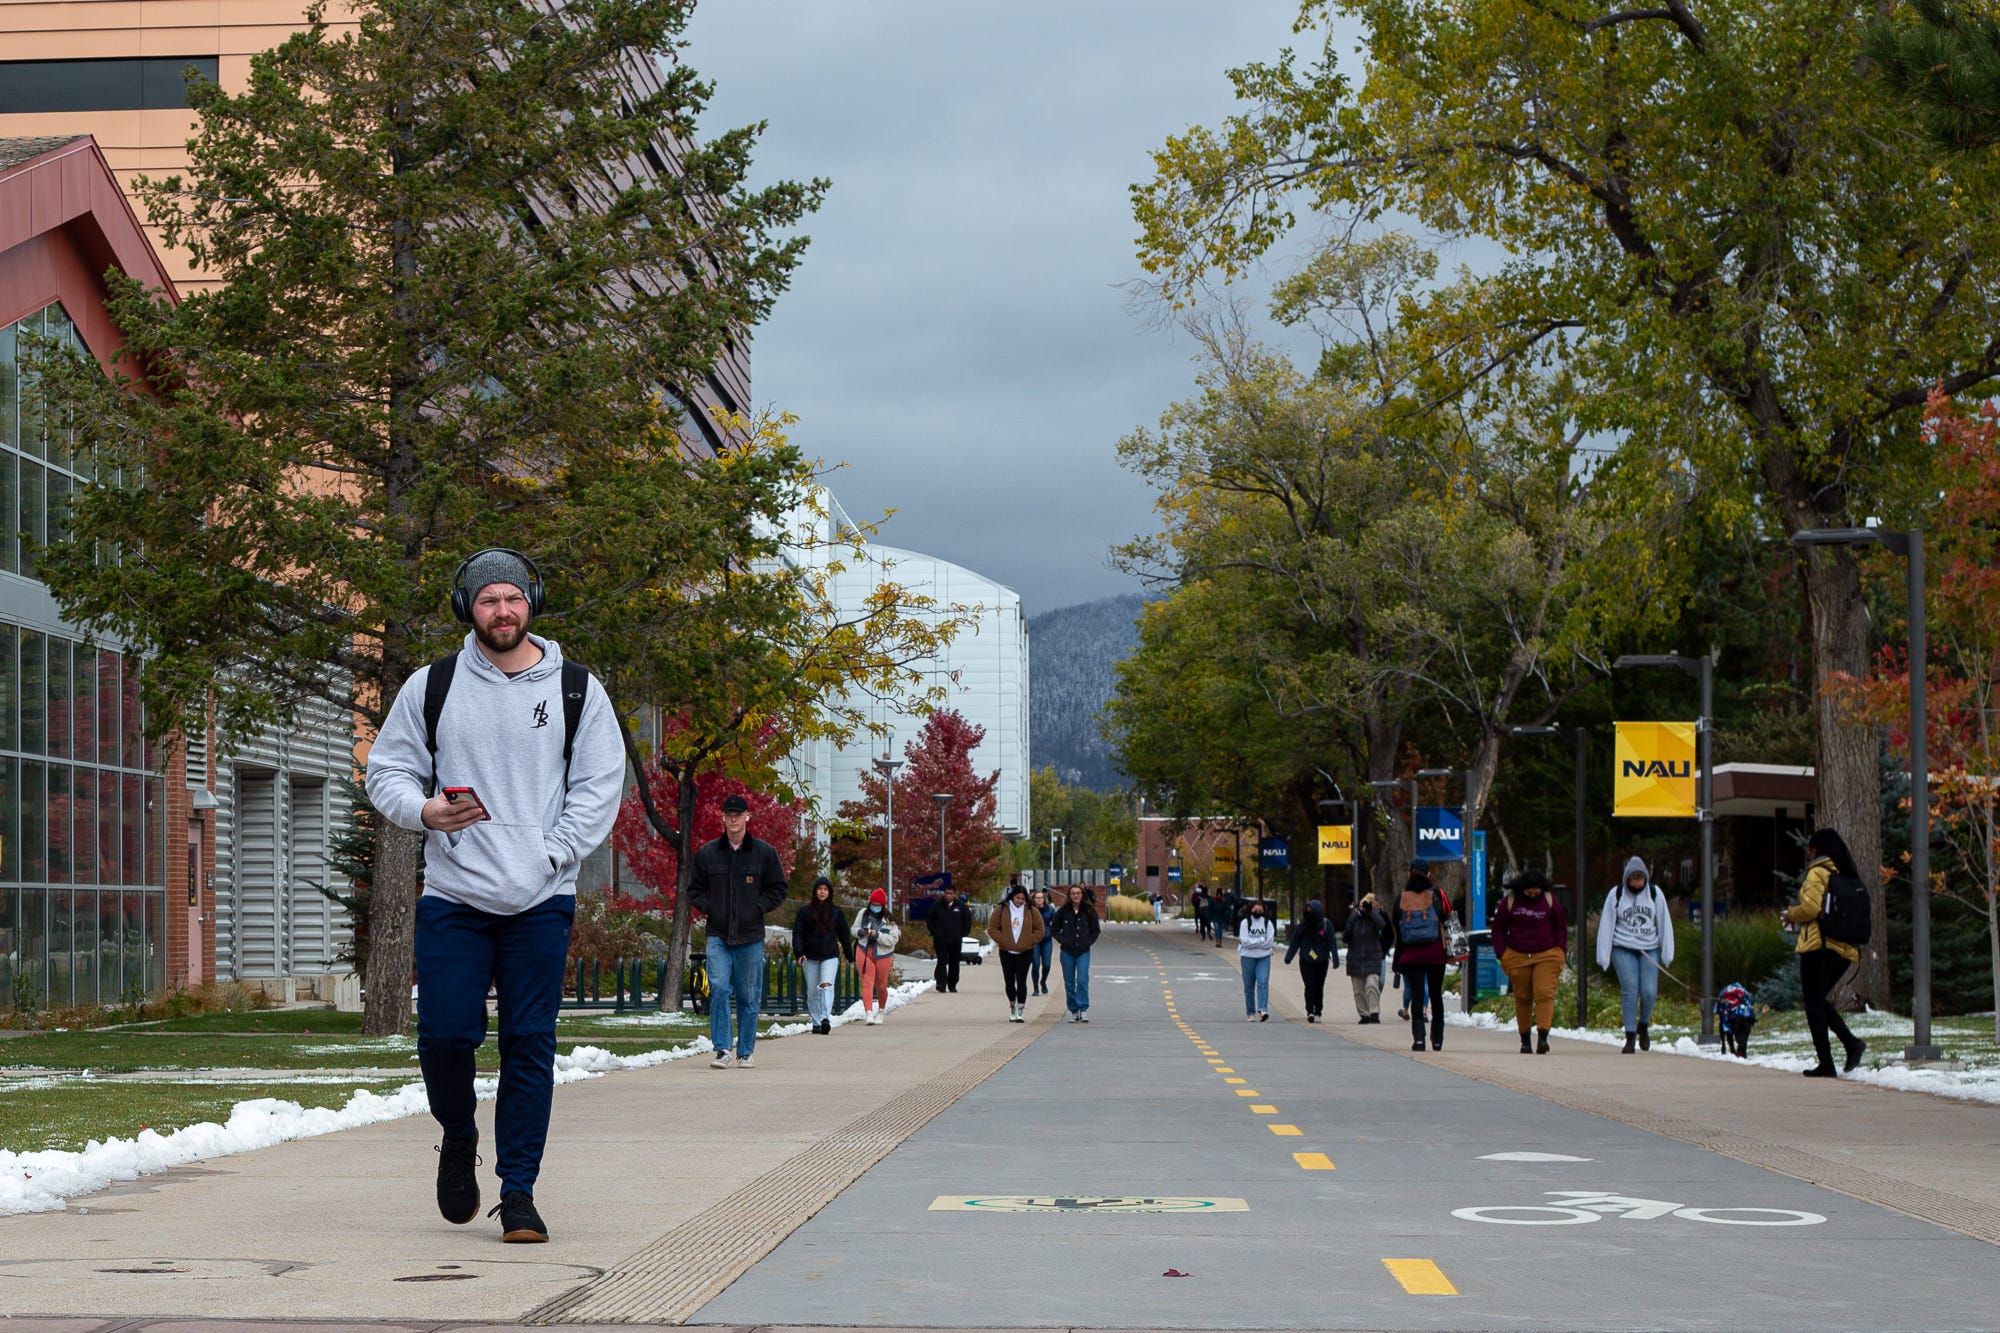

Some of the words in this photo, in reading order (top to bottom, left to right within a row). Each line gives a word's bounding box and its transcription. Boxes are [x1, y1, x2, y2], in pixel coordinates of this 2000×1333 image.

[1623, 760, 1690, 777] NAU
[1419, 828, 1460, 840] NAU
[1322, 841, 1349, 849] NAU
[1263, 848, 1287, 856] NAU
